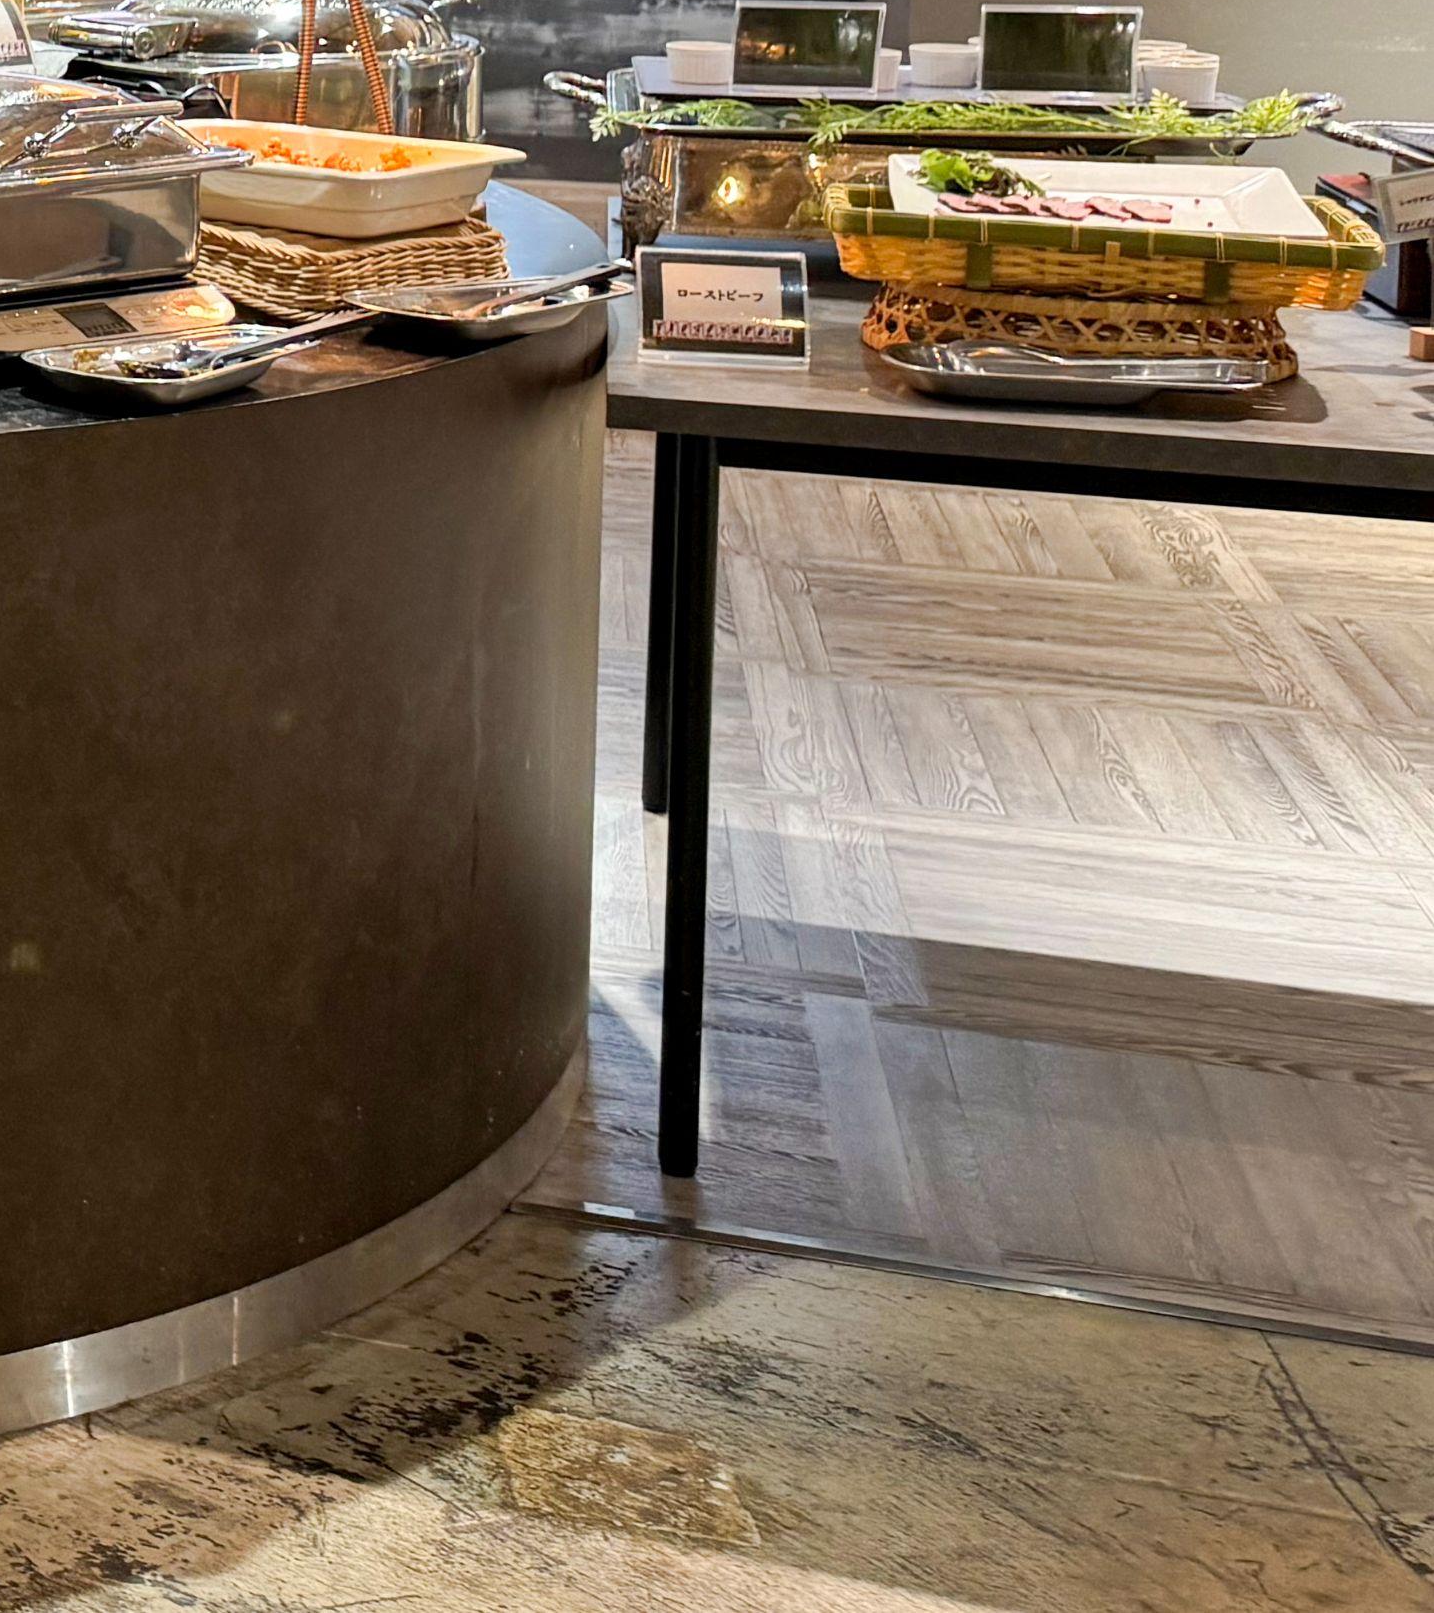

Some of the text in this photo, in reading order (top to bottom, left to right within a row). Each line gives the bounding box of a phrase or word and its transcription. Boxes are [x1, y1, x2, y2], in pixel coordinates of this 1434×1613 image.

[677, 289, 764, 302] ローストビーフ
